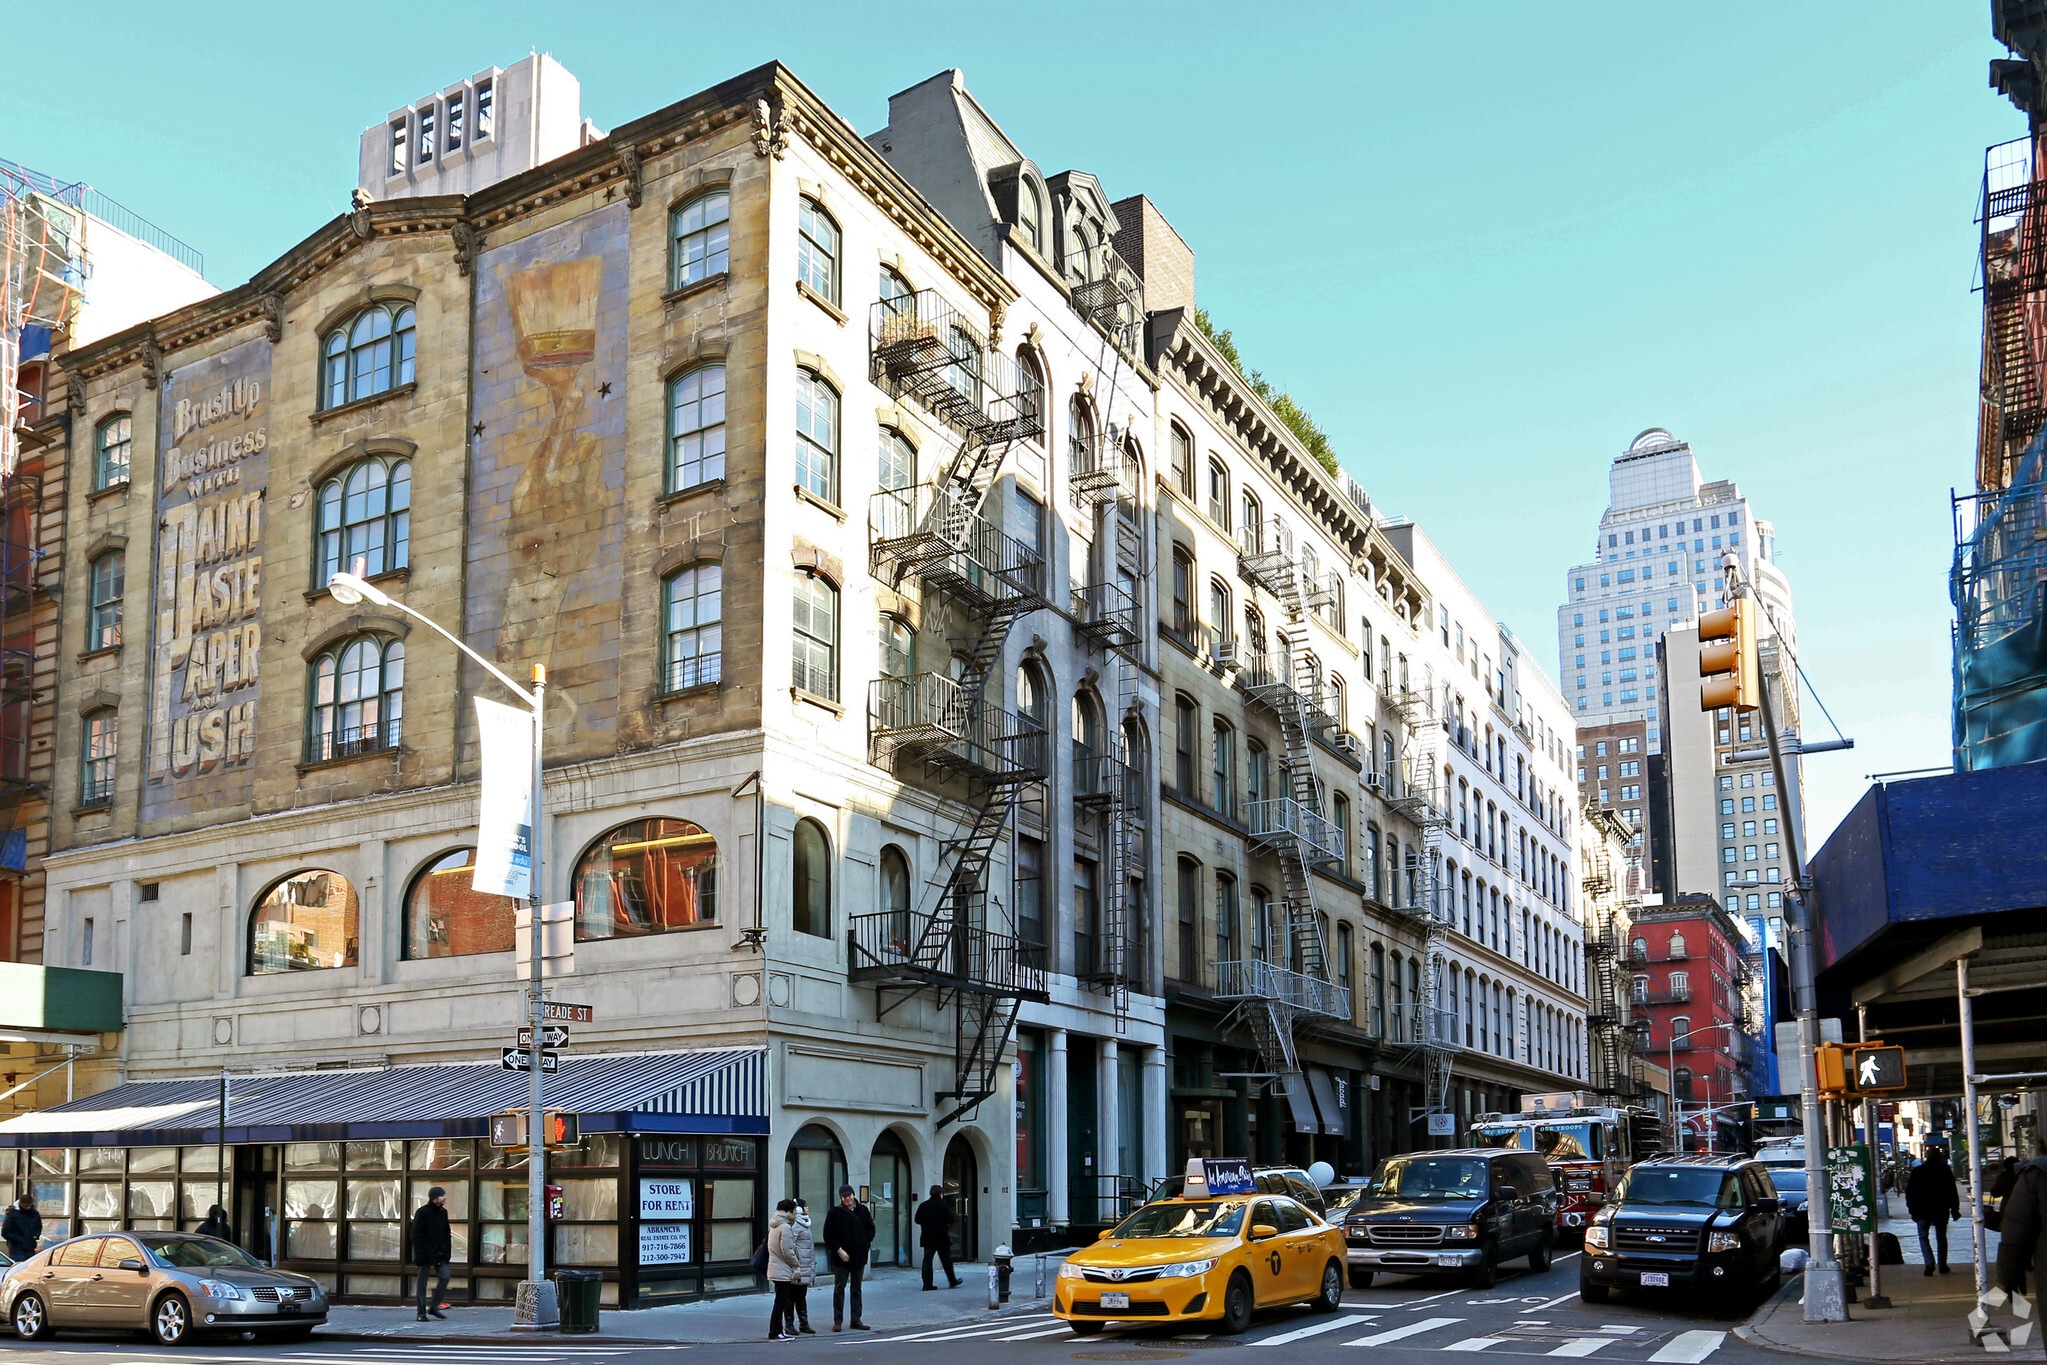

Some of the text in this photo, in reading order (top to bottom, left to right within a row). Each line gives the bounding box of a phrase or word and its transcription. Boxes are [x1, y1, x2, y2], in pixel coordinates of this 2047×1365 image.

[163, 427, 267, 499] Business
[187, 465, 240, 498] WITH
[544, 1004, 588, 1020] READE ST
[546, 1032, 562, 1041] WAY
[508, 1055, 527, 1064] ONE
[1335, 1076, 1348, 1108] Jacadi
[642, 1141, 689, 1160] LUNCH
[706, 1143, 748, 1161] BRUNCH
[649, 1184, 681, 1194] STORE
[642, 1200, 690, 1210] FOR RENT
